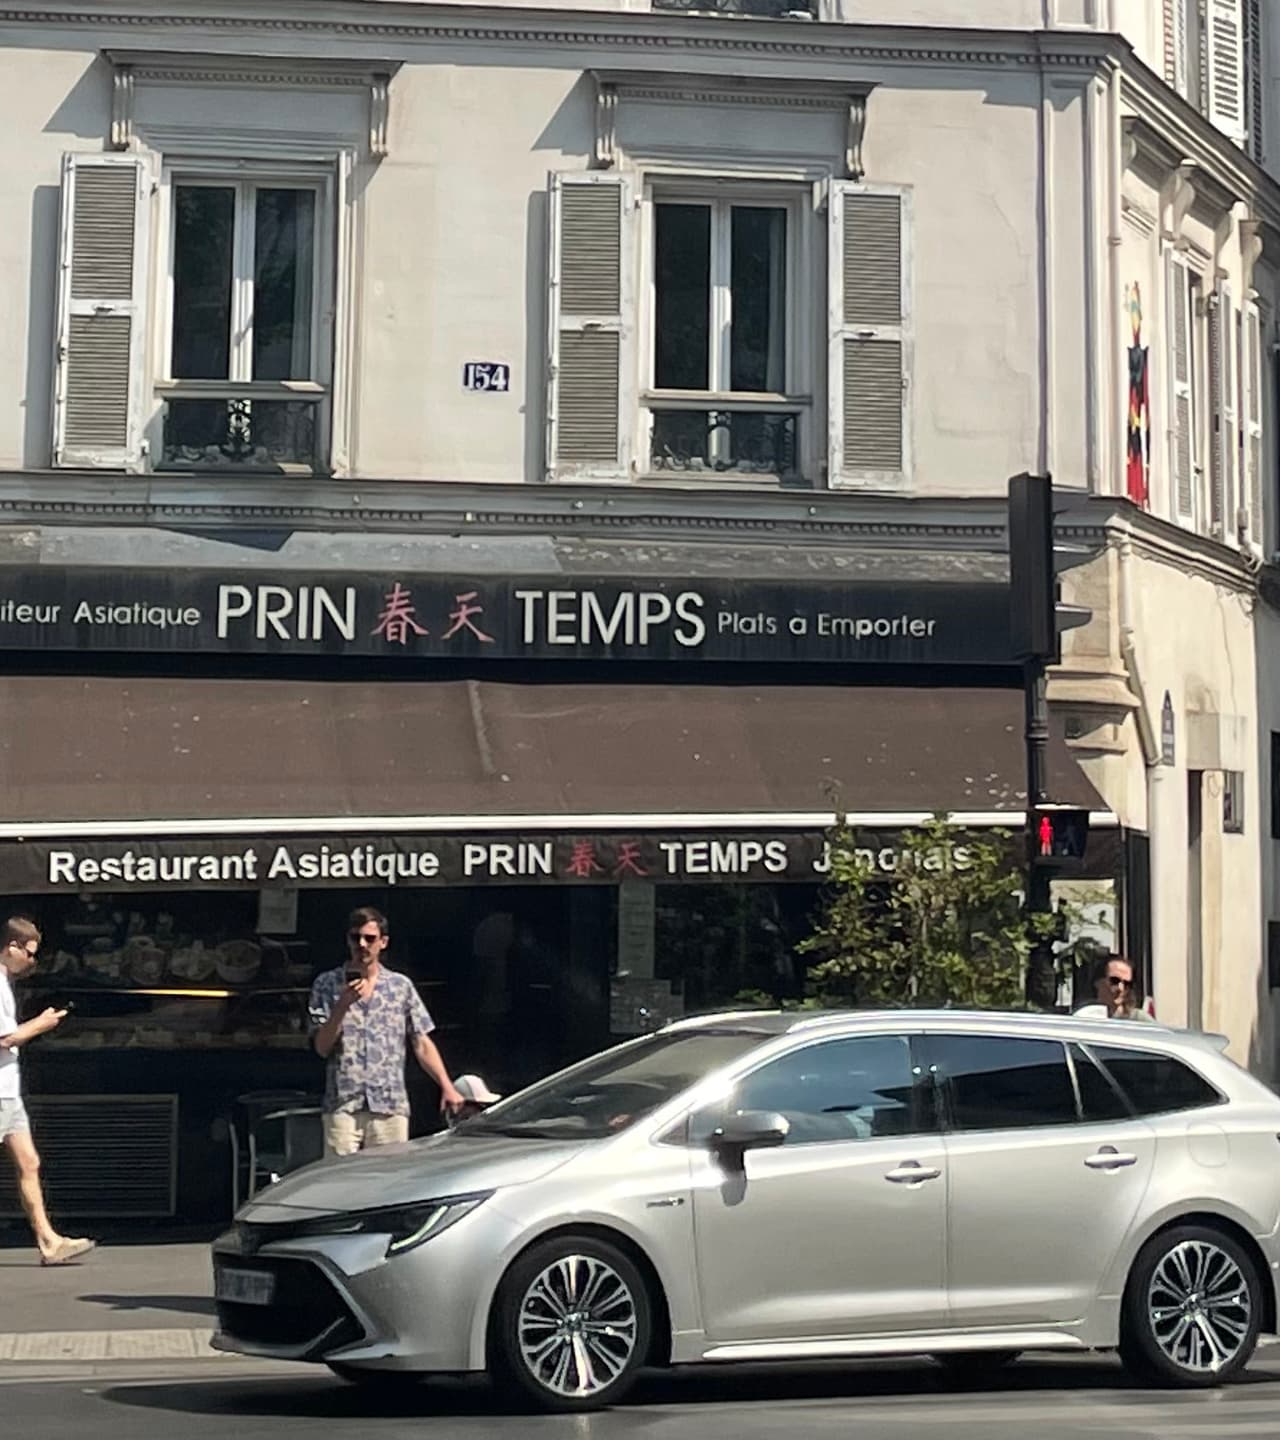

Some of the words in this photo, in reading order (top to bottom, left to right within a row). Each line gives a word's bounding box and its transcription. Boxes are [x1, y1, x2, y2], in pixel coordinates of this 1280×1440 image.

[467, 364, 507, 390] 154
[73, 600, 201, 630] Asiatique
[217, 584, 356, 641] PRIN
[515, 590, 706, 647] TEMPS
[718, 611, 777, 636] Plats
[818, 613, 937, 640] Emporter
[49, 844, 258, 883] Restaurant
[267, 846, 440, 885] Asiatique
[463, 843, 553, 876] PRIN
[659, 840, 788, 874] TEMPS
